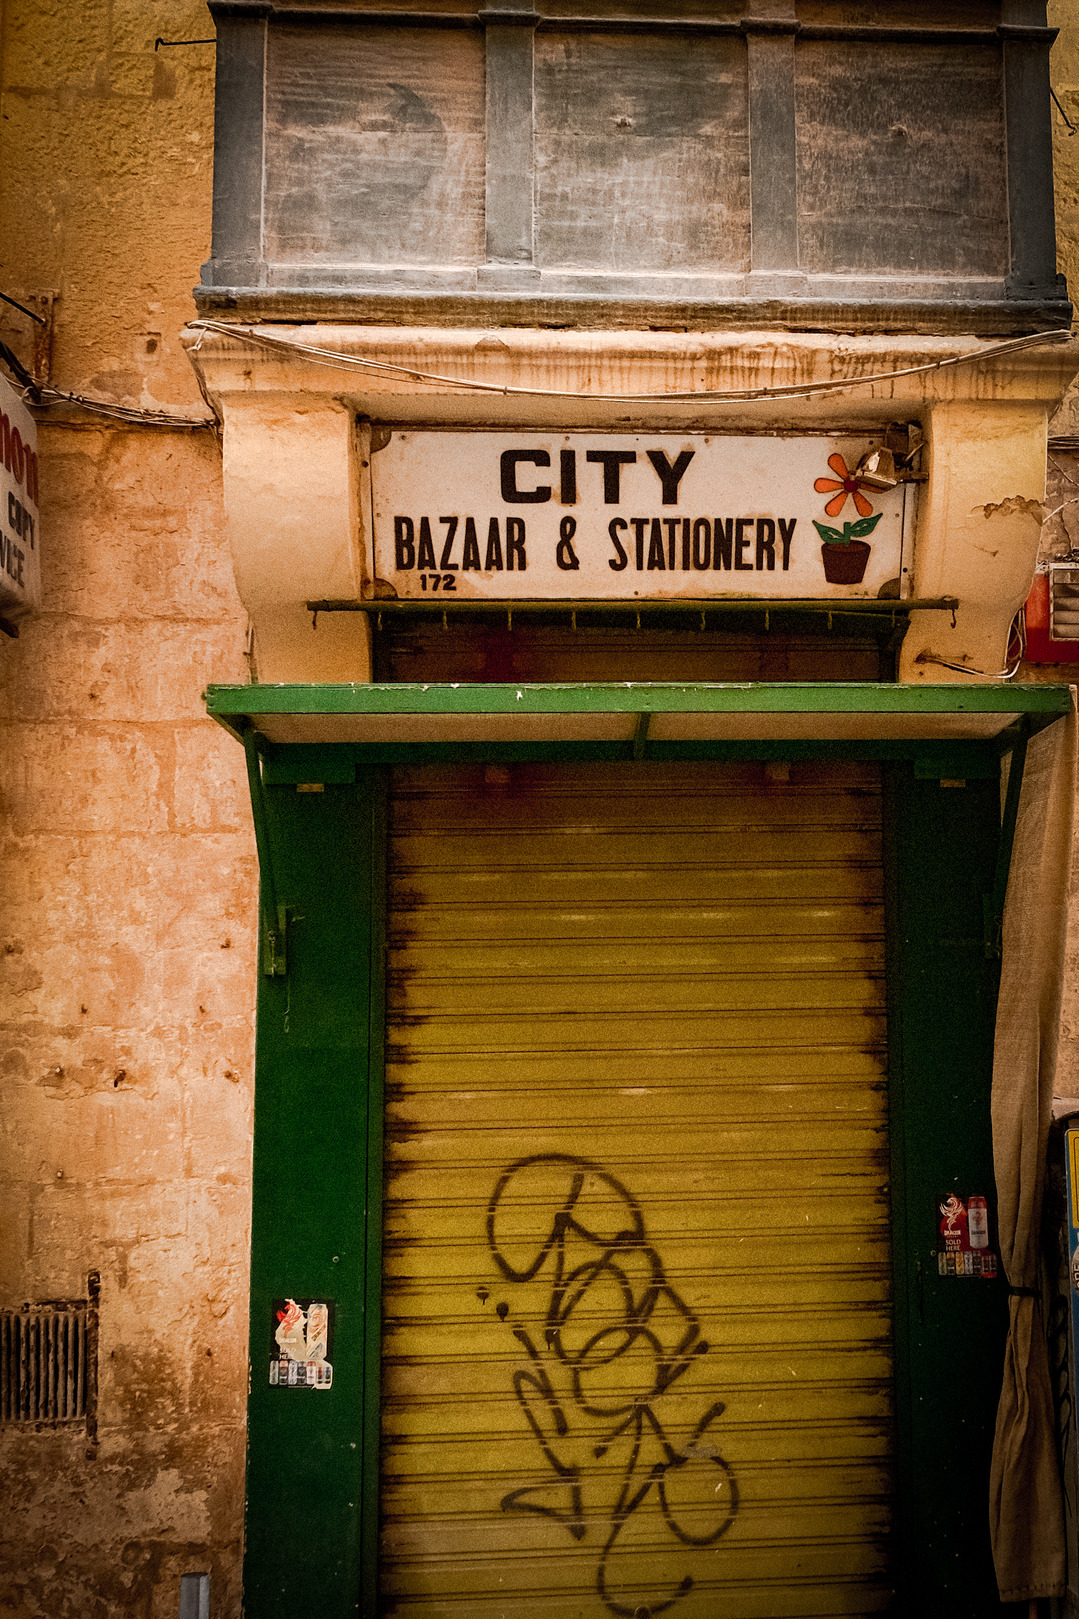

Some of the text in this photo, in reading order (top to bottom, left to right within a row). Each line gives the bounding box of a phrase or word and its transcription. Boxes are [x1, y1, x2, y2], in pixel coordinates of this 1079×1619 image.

[501, 449, 696, 505] CITY
[8, 491, 35, 550] COPY
[394, 515, 797, 571] BAZAAR & STATIONERY
[420, 573, 457, 592] 172
